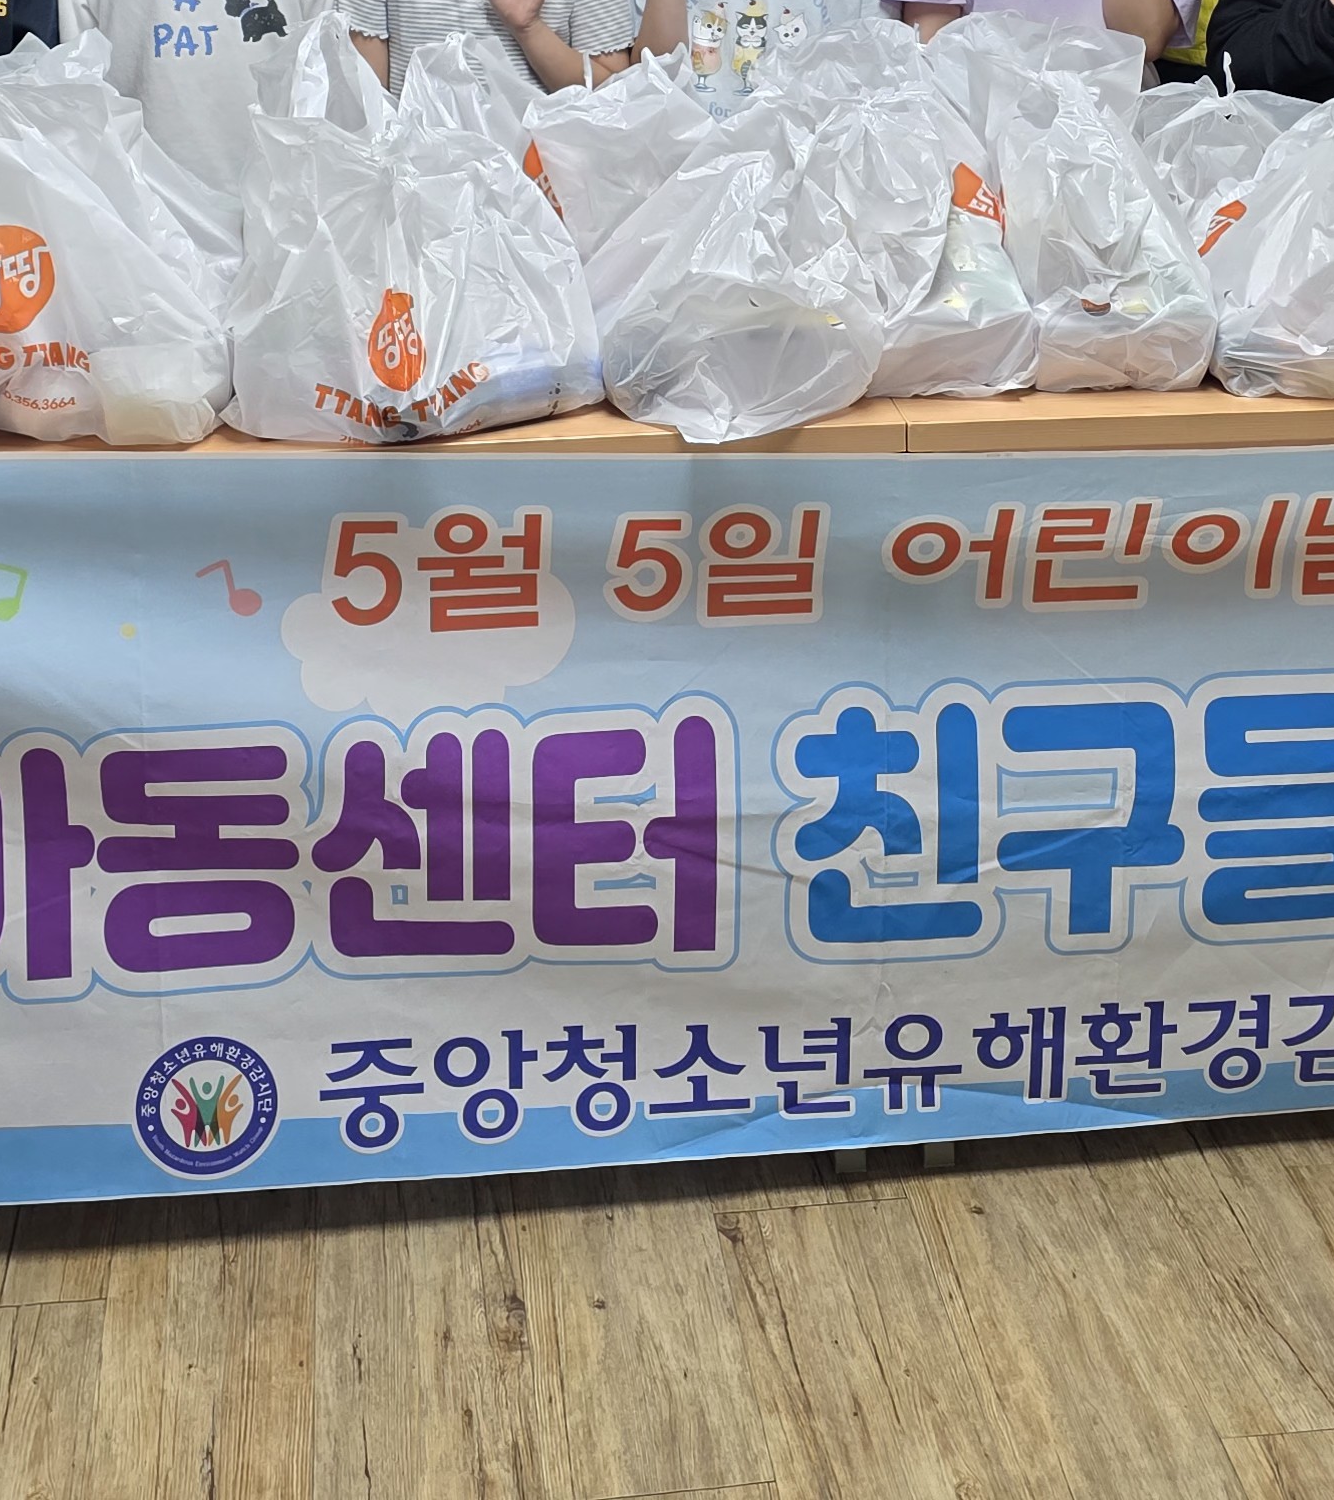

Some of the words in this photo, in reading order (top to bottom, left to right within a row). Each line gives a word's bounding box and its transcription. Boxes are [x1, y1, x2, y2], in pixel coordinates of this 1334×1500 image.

[153, 23, 219, 58] PAT
[708, 101, 731, 118] for
[315, 383, 402, 428] TTANG
[331, 514, 541, 632] 5월
[613, 509, 817, 618] 5일
[141, 1043, 272, 1118] 중앙청소년유해환경감시단
